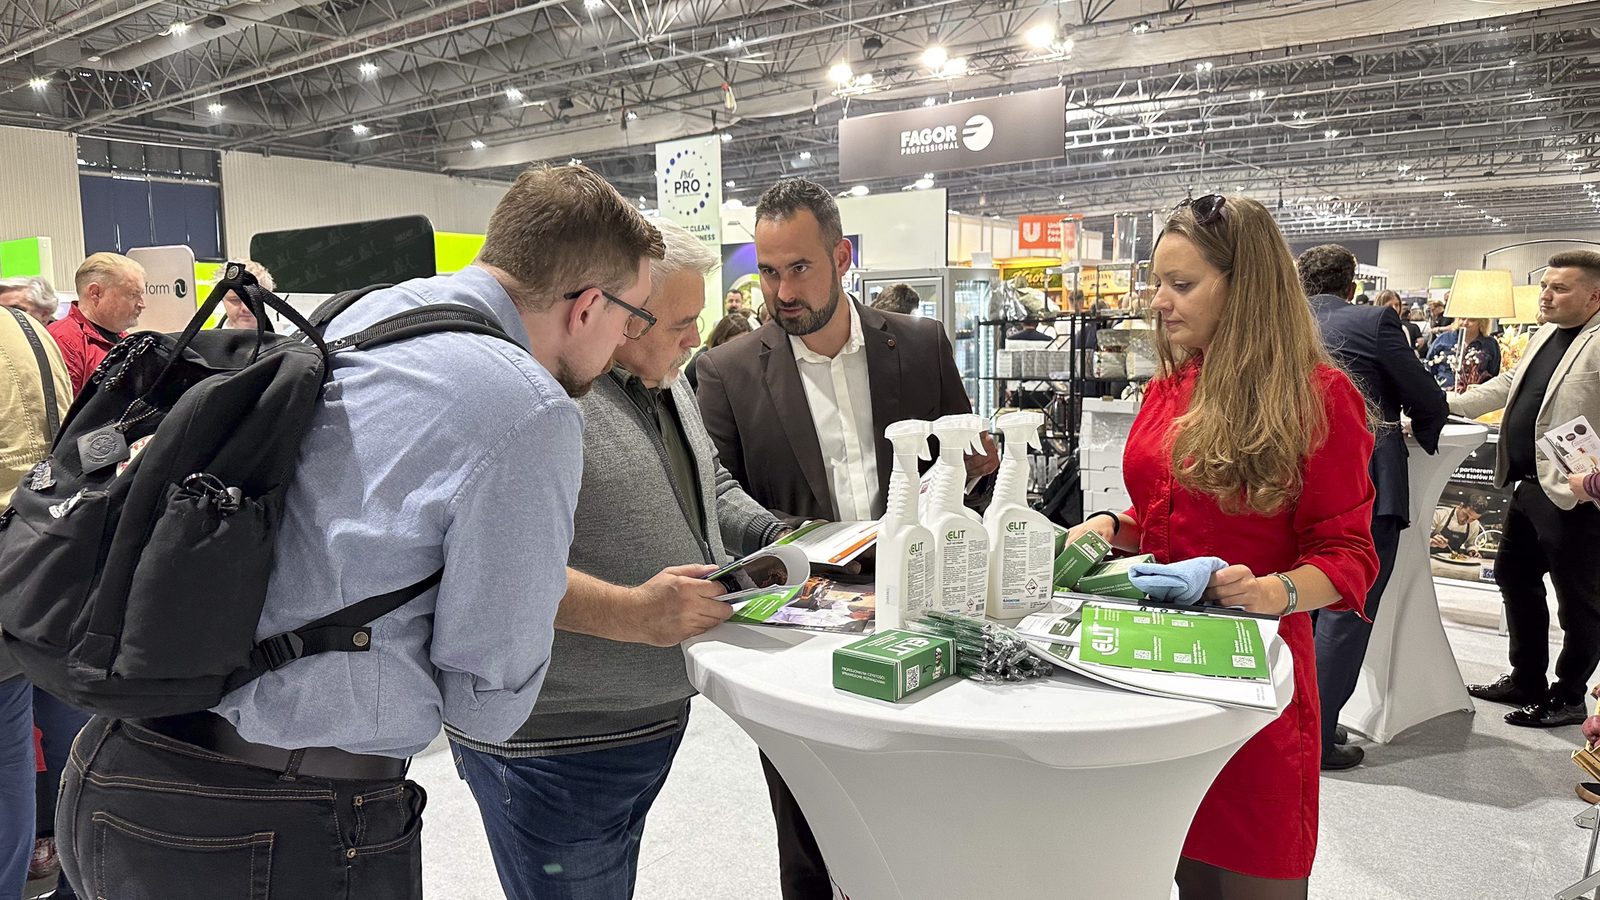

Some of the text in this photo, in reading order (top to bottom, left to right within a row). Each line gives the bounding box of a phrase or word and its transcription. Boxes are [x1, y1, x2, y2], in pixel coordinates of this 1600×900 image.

[901, 125, 957, 147] FAGOR
[901, 141, 959, 155] PROFESSIONAL
[675, 179, 700, 194] PRO
[690, 224, 710, 232] CLEAN
[1460, 467, 1493, 475] partnerem
[1008, 521, 1027, 531] ELIT
[947, 529, 966, 540] ELIT
[911, 541, 924, 553] ELIT
[1091, 622, 1115, 654] ELIT
